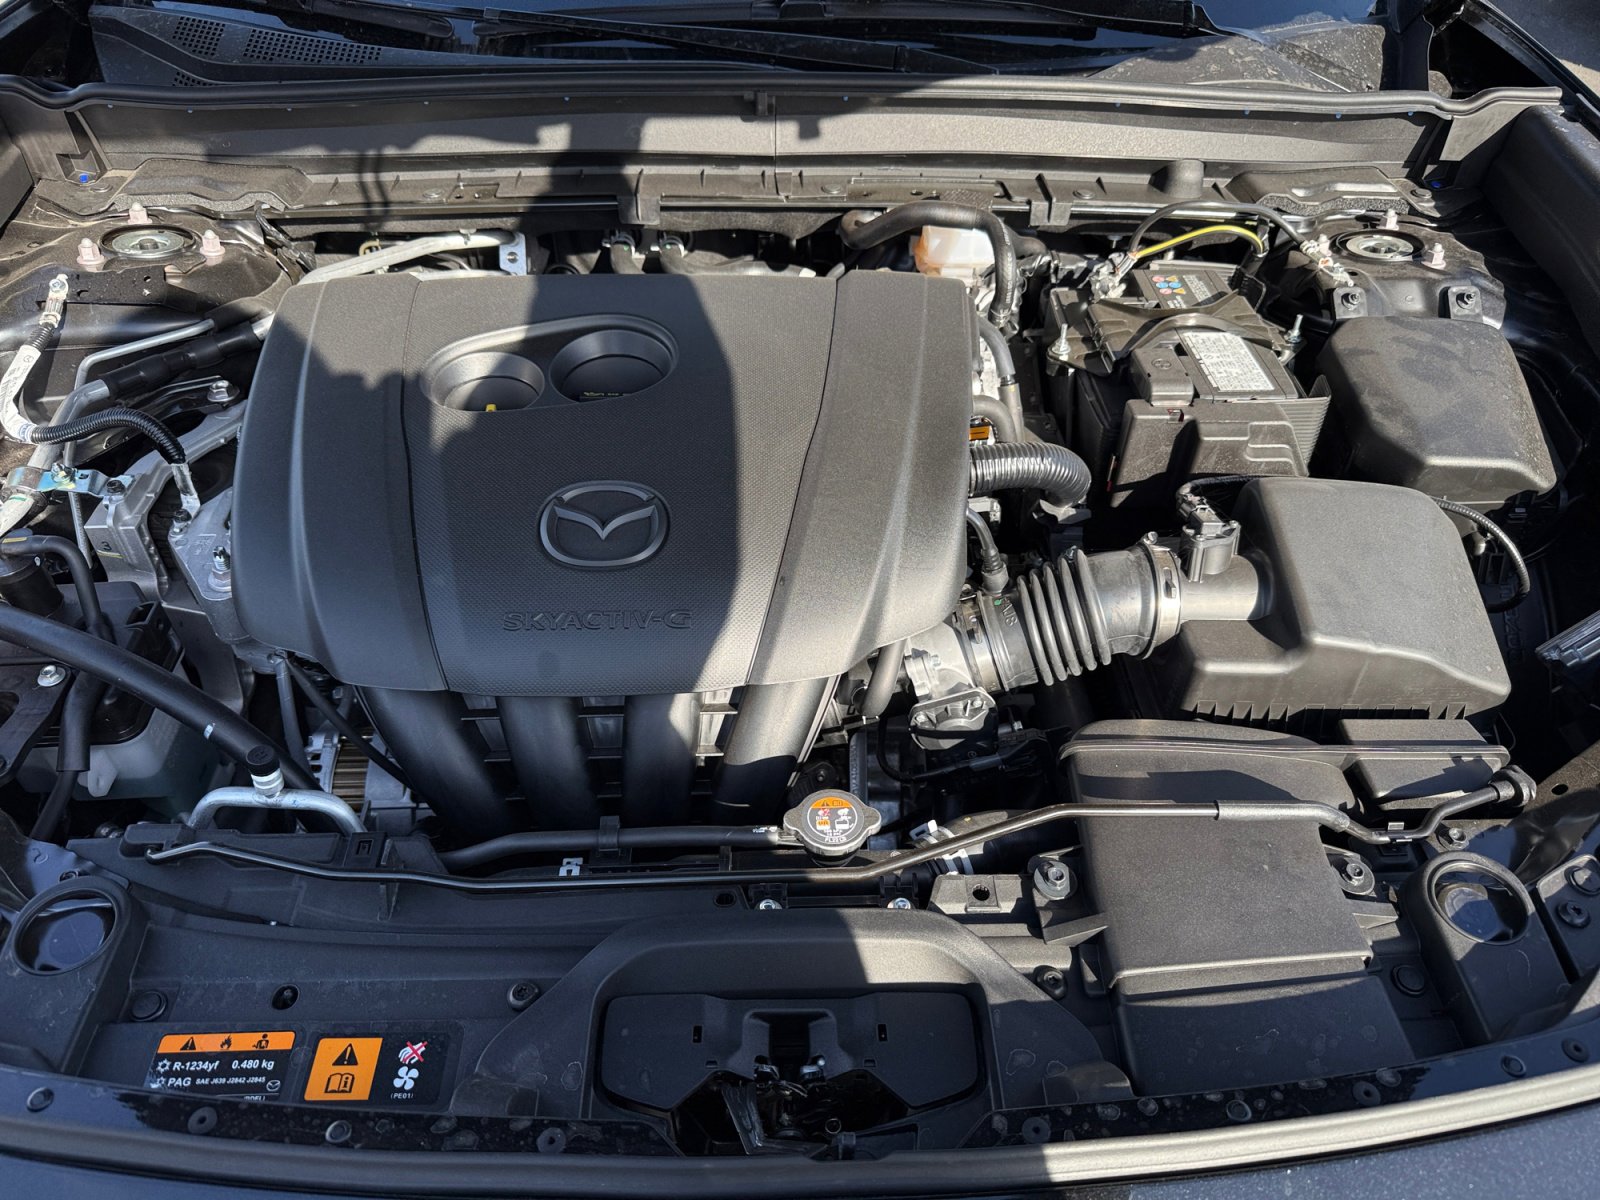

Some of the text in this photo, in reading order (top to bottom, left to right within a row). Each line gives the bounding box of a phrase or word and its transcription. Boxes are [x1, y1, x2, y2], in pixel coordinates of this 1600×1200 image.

[502, 608, 693, 631] SKYACTIV-G
[172, 1059, 275, 1072] R-1234yf 0.480 kg
[167, 1077, 192, 1088] PAG
[195, 1078, 210, 1086] SAE
